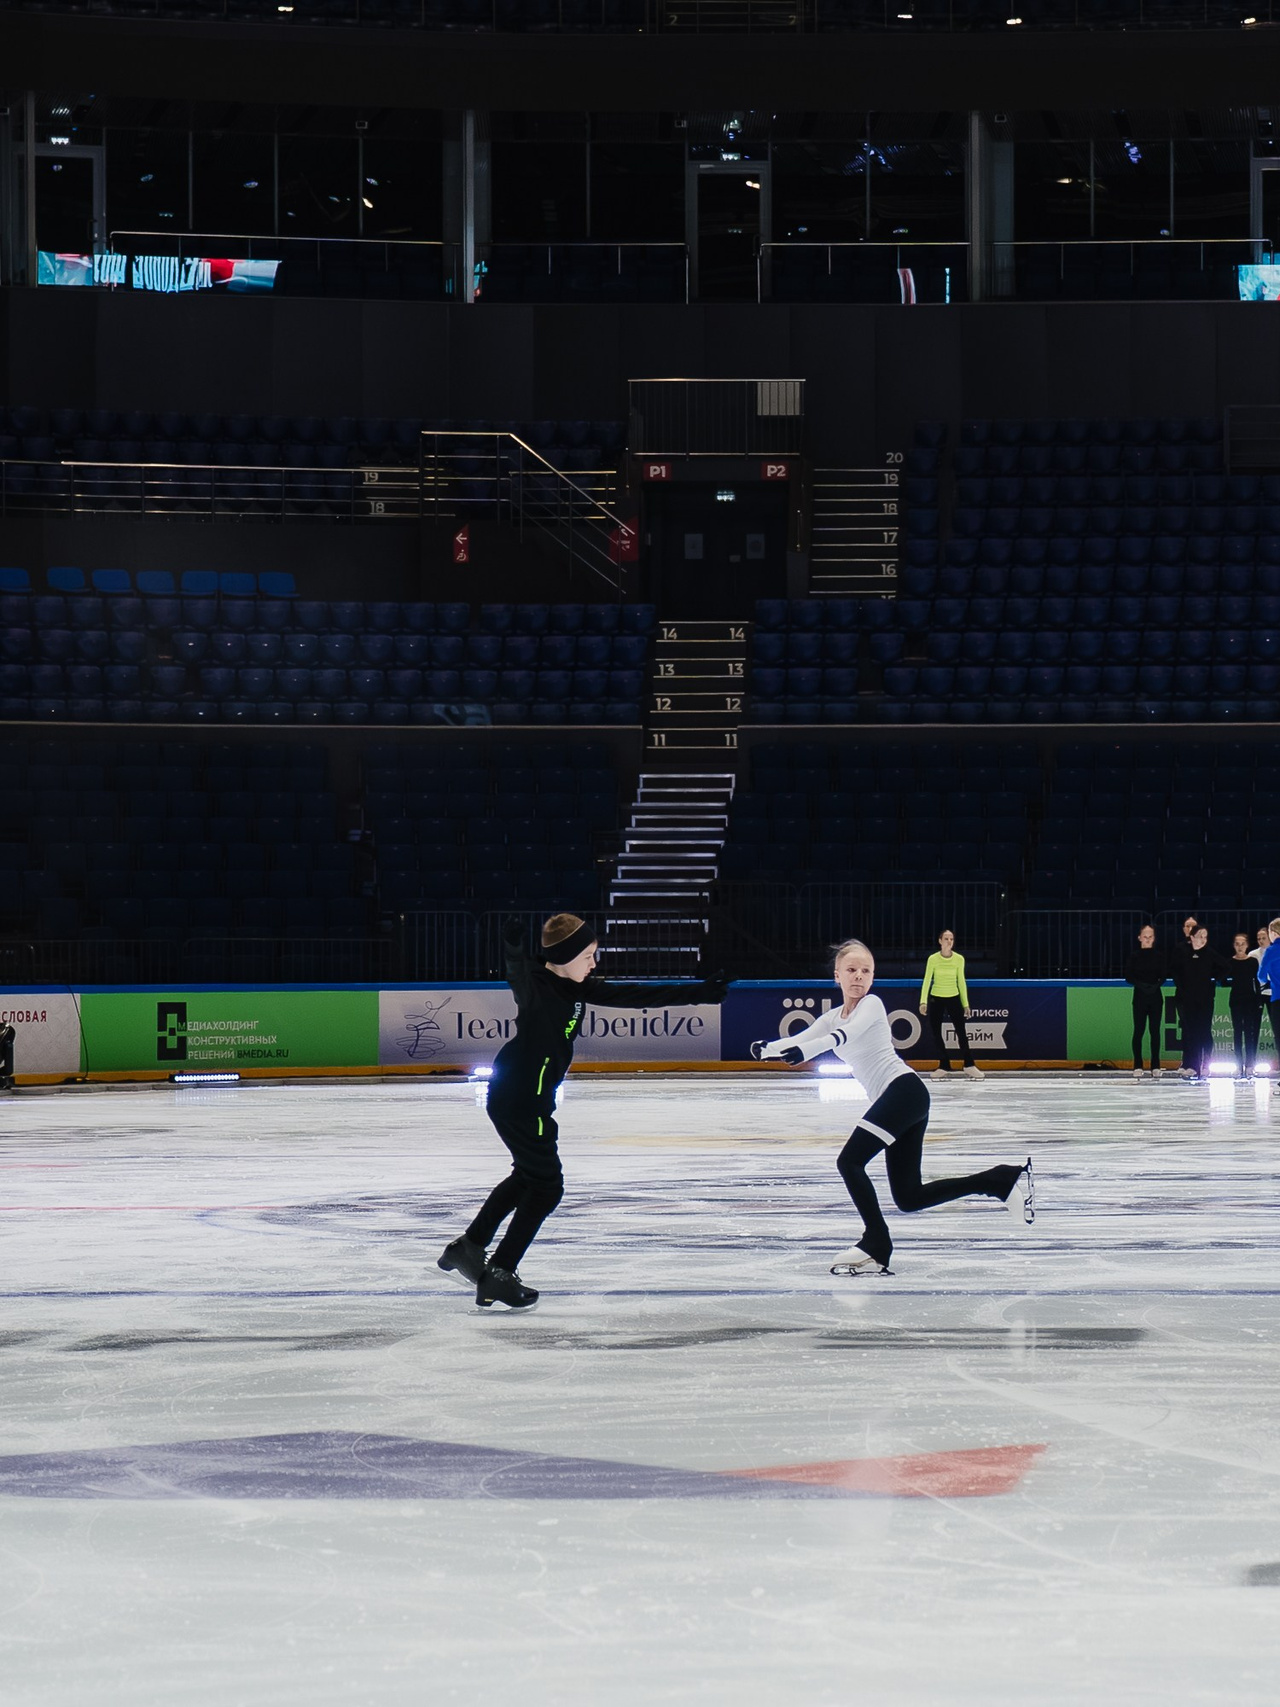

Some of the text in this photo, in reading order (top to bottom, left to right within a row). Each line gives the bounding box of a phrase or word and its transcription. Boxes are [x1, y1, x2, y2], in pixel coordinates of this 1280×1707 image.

[886, 452, 904, 464] 20
[649, 466, 666, 478] P1
[767, 465, 786, 477] P2
[364, 472, 379, 483] 19
[884, 473, 899, 485] 19
[370, 502, 385, 514] 18
[883, 503, 898, 514] 18
[883, 532, 898, 544] 17
[881, 564, 896, 576] 16
[662, 627, 677, 640] 14
[729, 627, 745, 640] 14
[659, 664, 675, 676] 13
[728, 663, 744, 676] 13
[656, 698, 671, 710] 12
[726, 698, 741, 710] 12
[653, 734, 666, 746] 11
[724, 734, 738, 746] 11
[966, 1008, 1009, 1018] писке
[178, 1020, 259, 1032] МЕДИАХОЛДИНГ
[577, 1009, 705, 1038] tberidze
[187, 1035, 278, 1046] КОНСТРУКТИВНЫХ
[946, 1028, 994, 1041] Пайм
[188, 1048, 235, 1060] РЕШЕНИЙ
